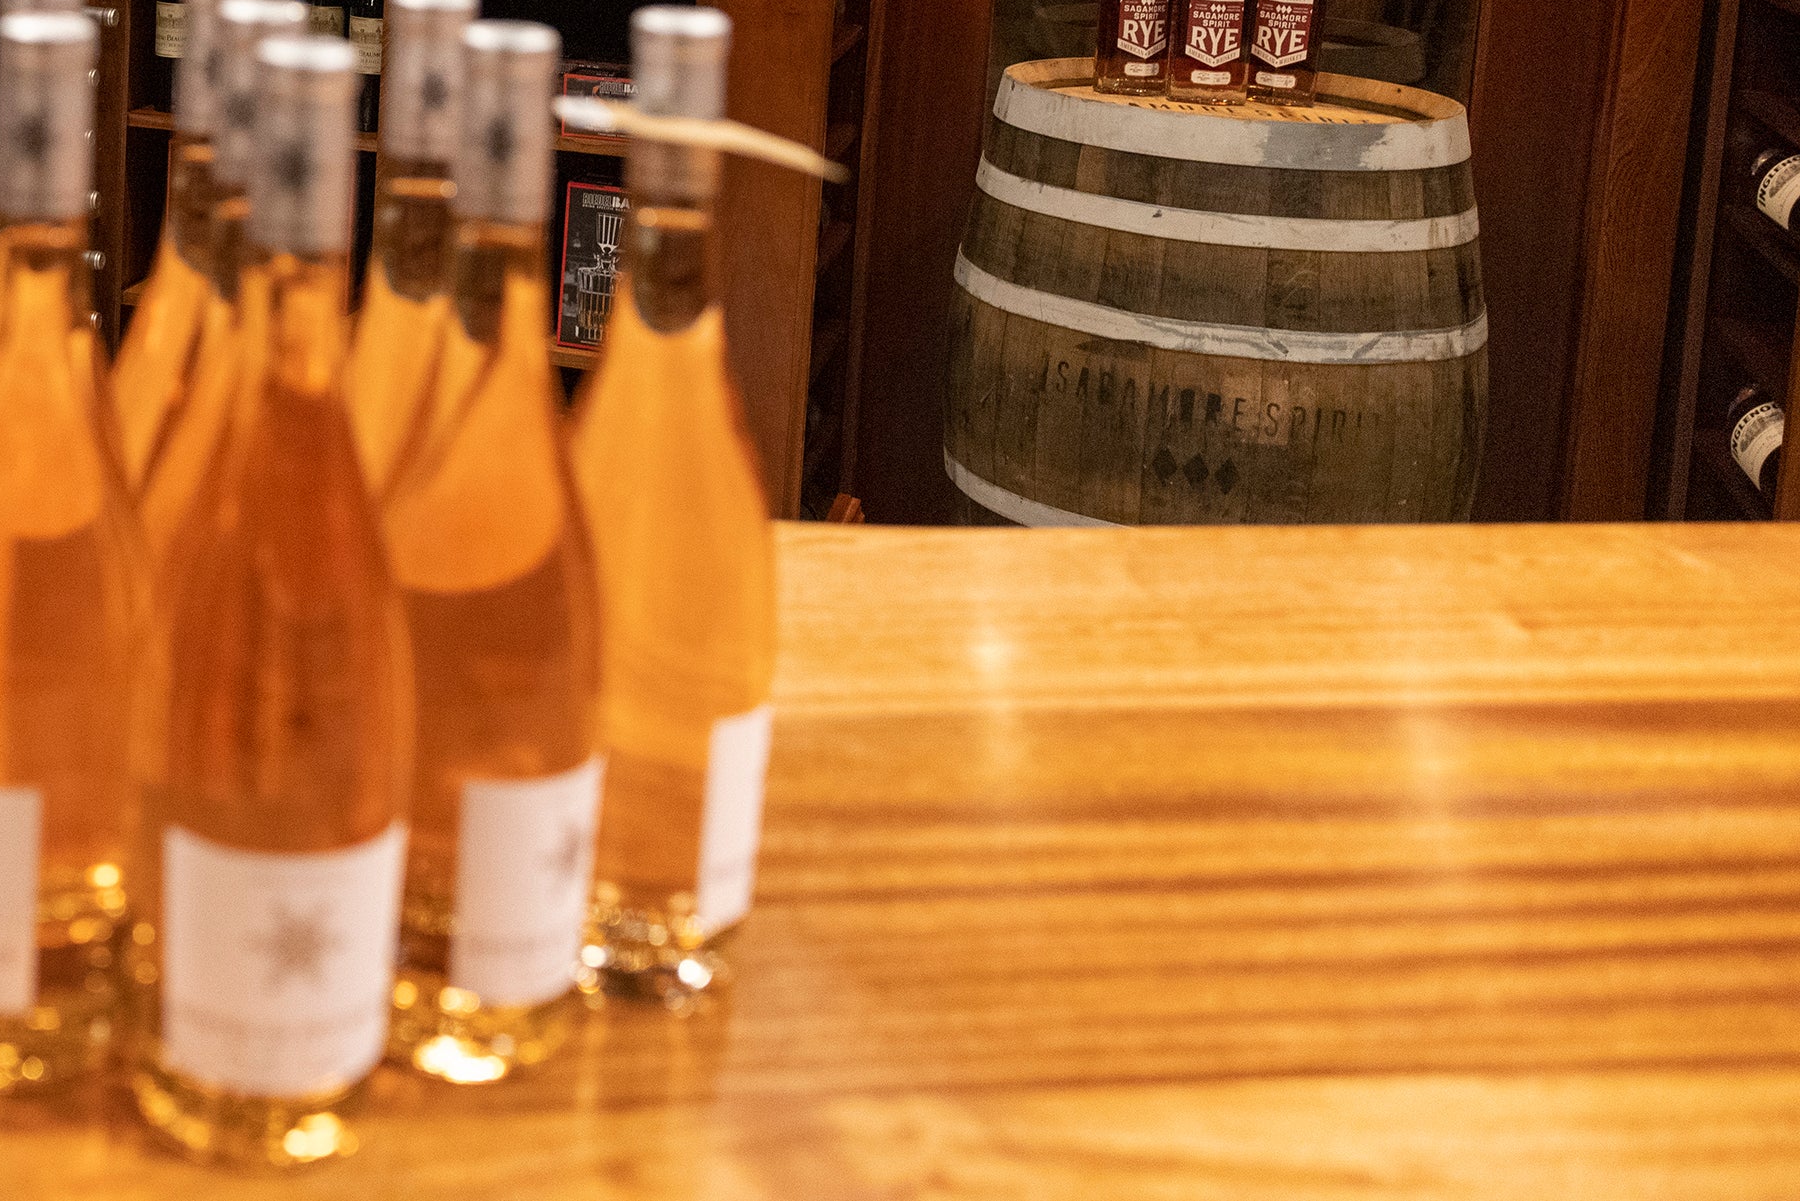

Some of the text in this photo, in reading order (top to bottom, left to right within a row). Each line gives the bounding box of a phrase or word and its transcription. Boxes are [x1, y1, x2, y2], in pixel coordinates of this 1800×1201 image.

[1124, 4, 1166, 13] SAGAMORE
[1134, 12, 1159, 20] SPIRIT
[1193, 10, 1240, 21] SAGAMORE
[1259, 10, 1308, 23] SAGAMORE
[1202, 19, 1231, 28] SPIRIT
[1268, 19, 1297, 29] SPIRIT
[1122, 19, 1166, 48] RYE
[1190, 25, 1239, 56] RYE
[1256, 25, 1306, 57] RYE
